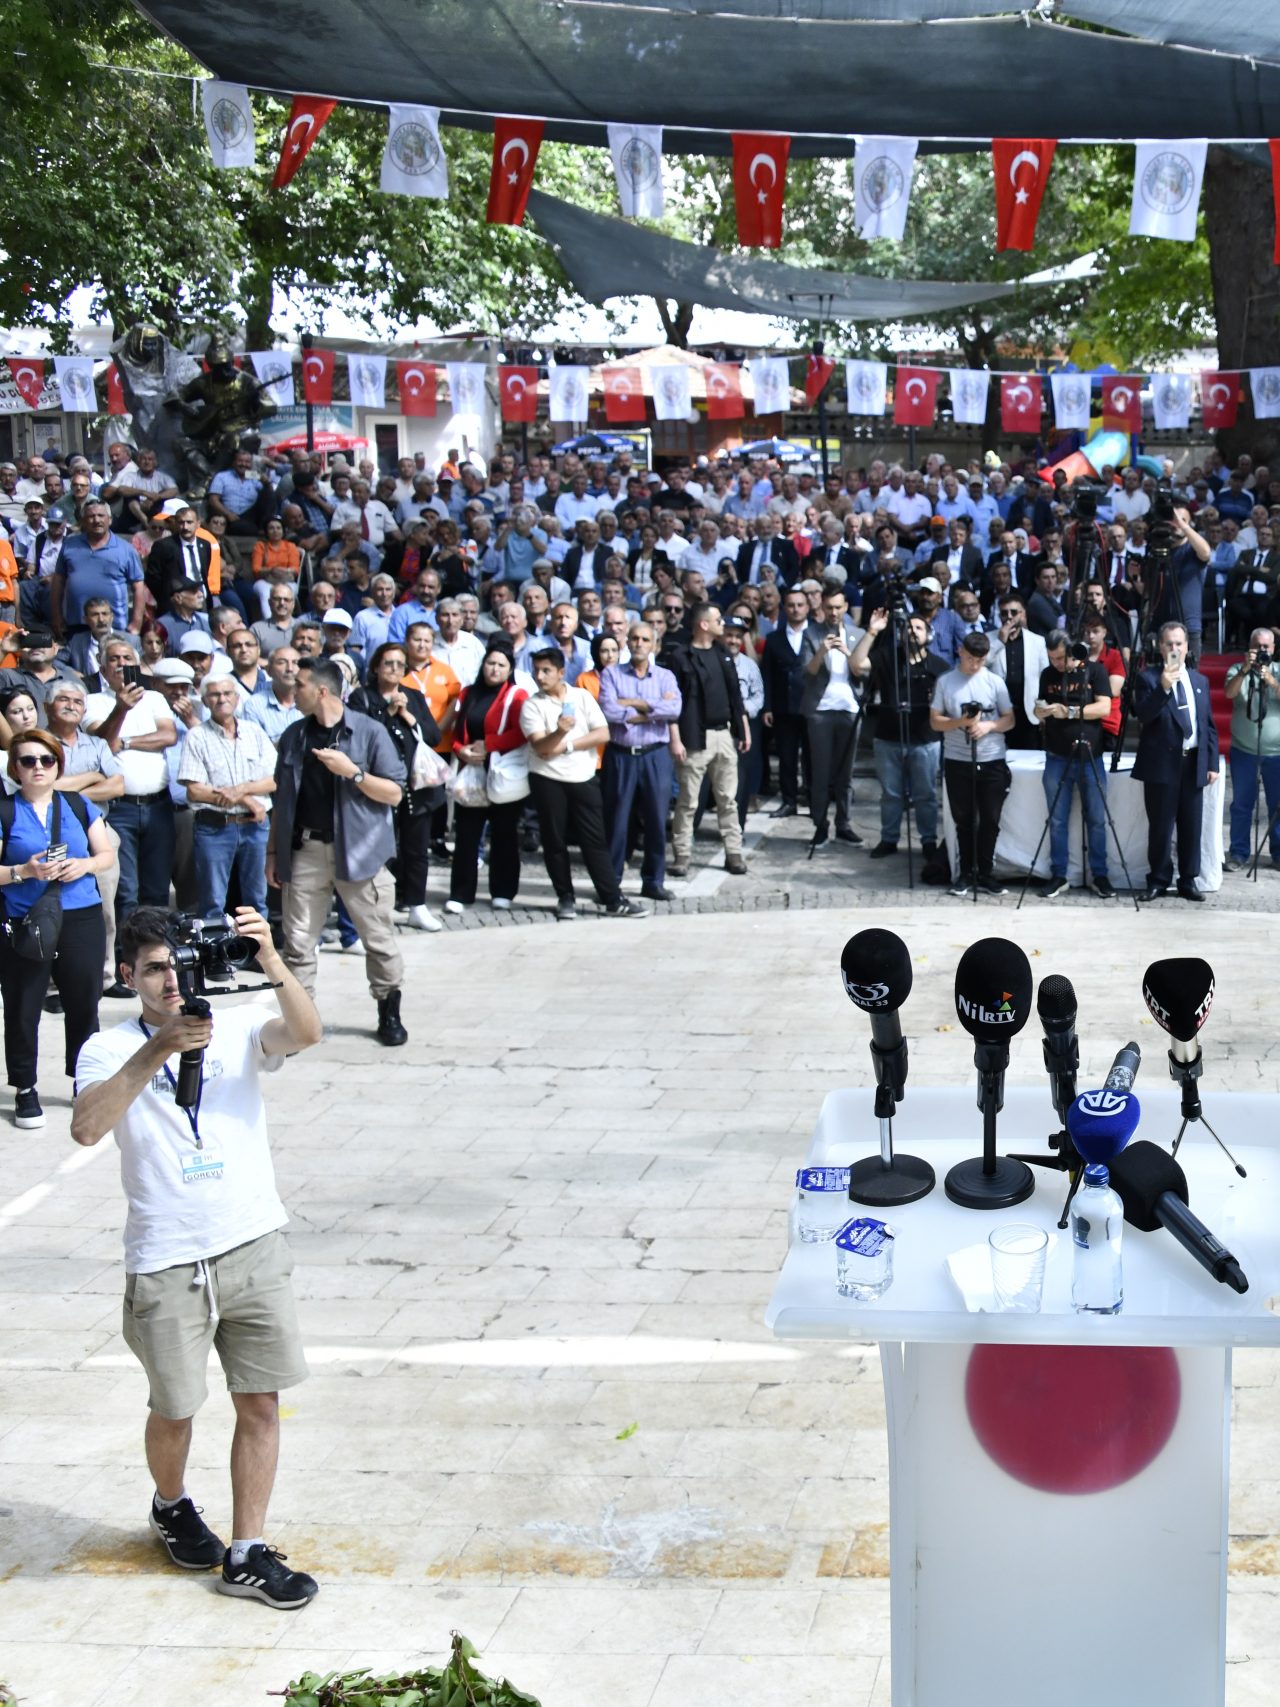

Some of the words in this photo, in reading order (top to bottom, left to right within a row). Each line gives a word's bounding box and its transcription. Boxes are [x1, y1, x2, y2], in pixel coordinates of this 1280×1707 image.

[876, 1000, 889, 1008] 33
[1145, 984, 1171, 1021] TRT
[1194, 979, 1216, 1018] TRT
